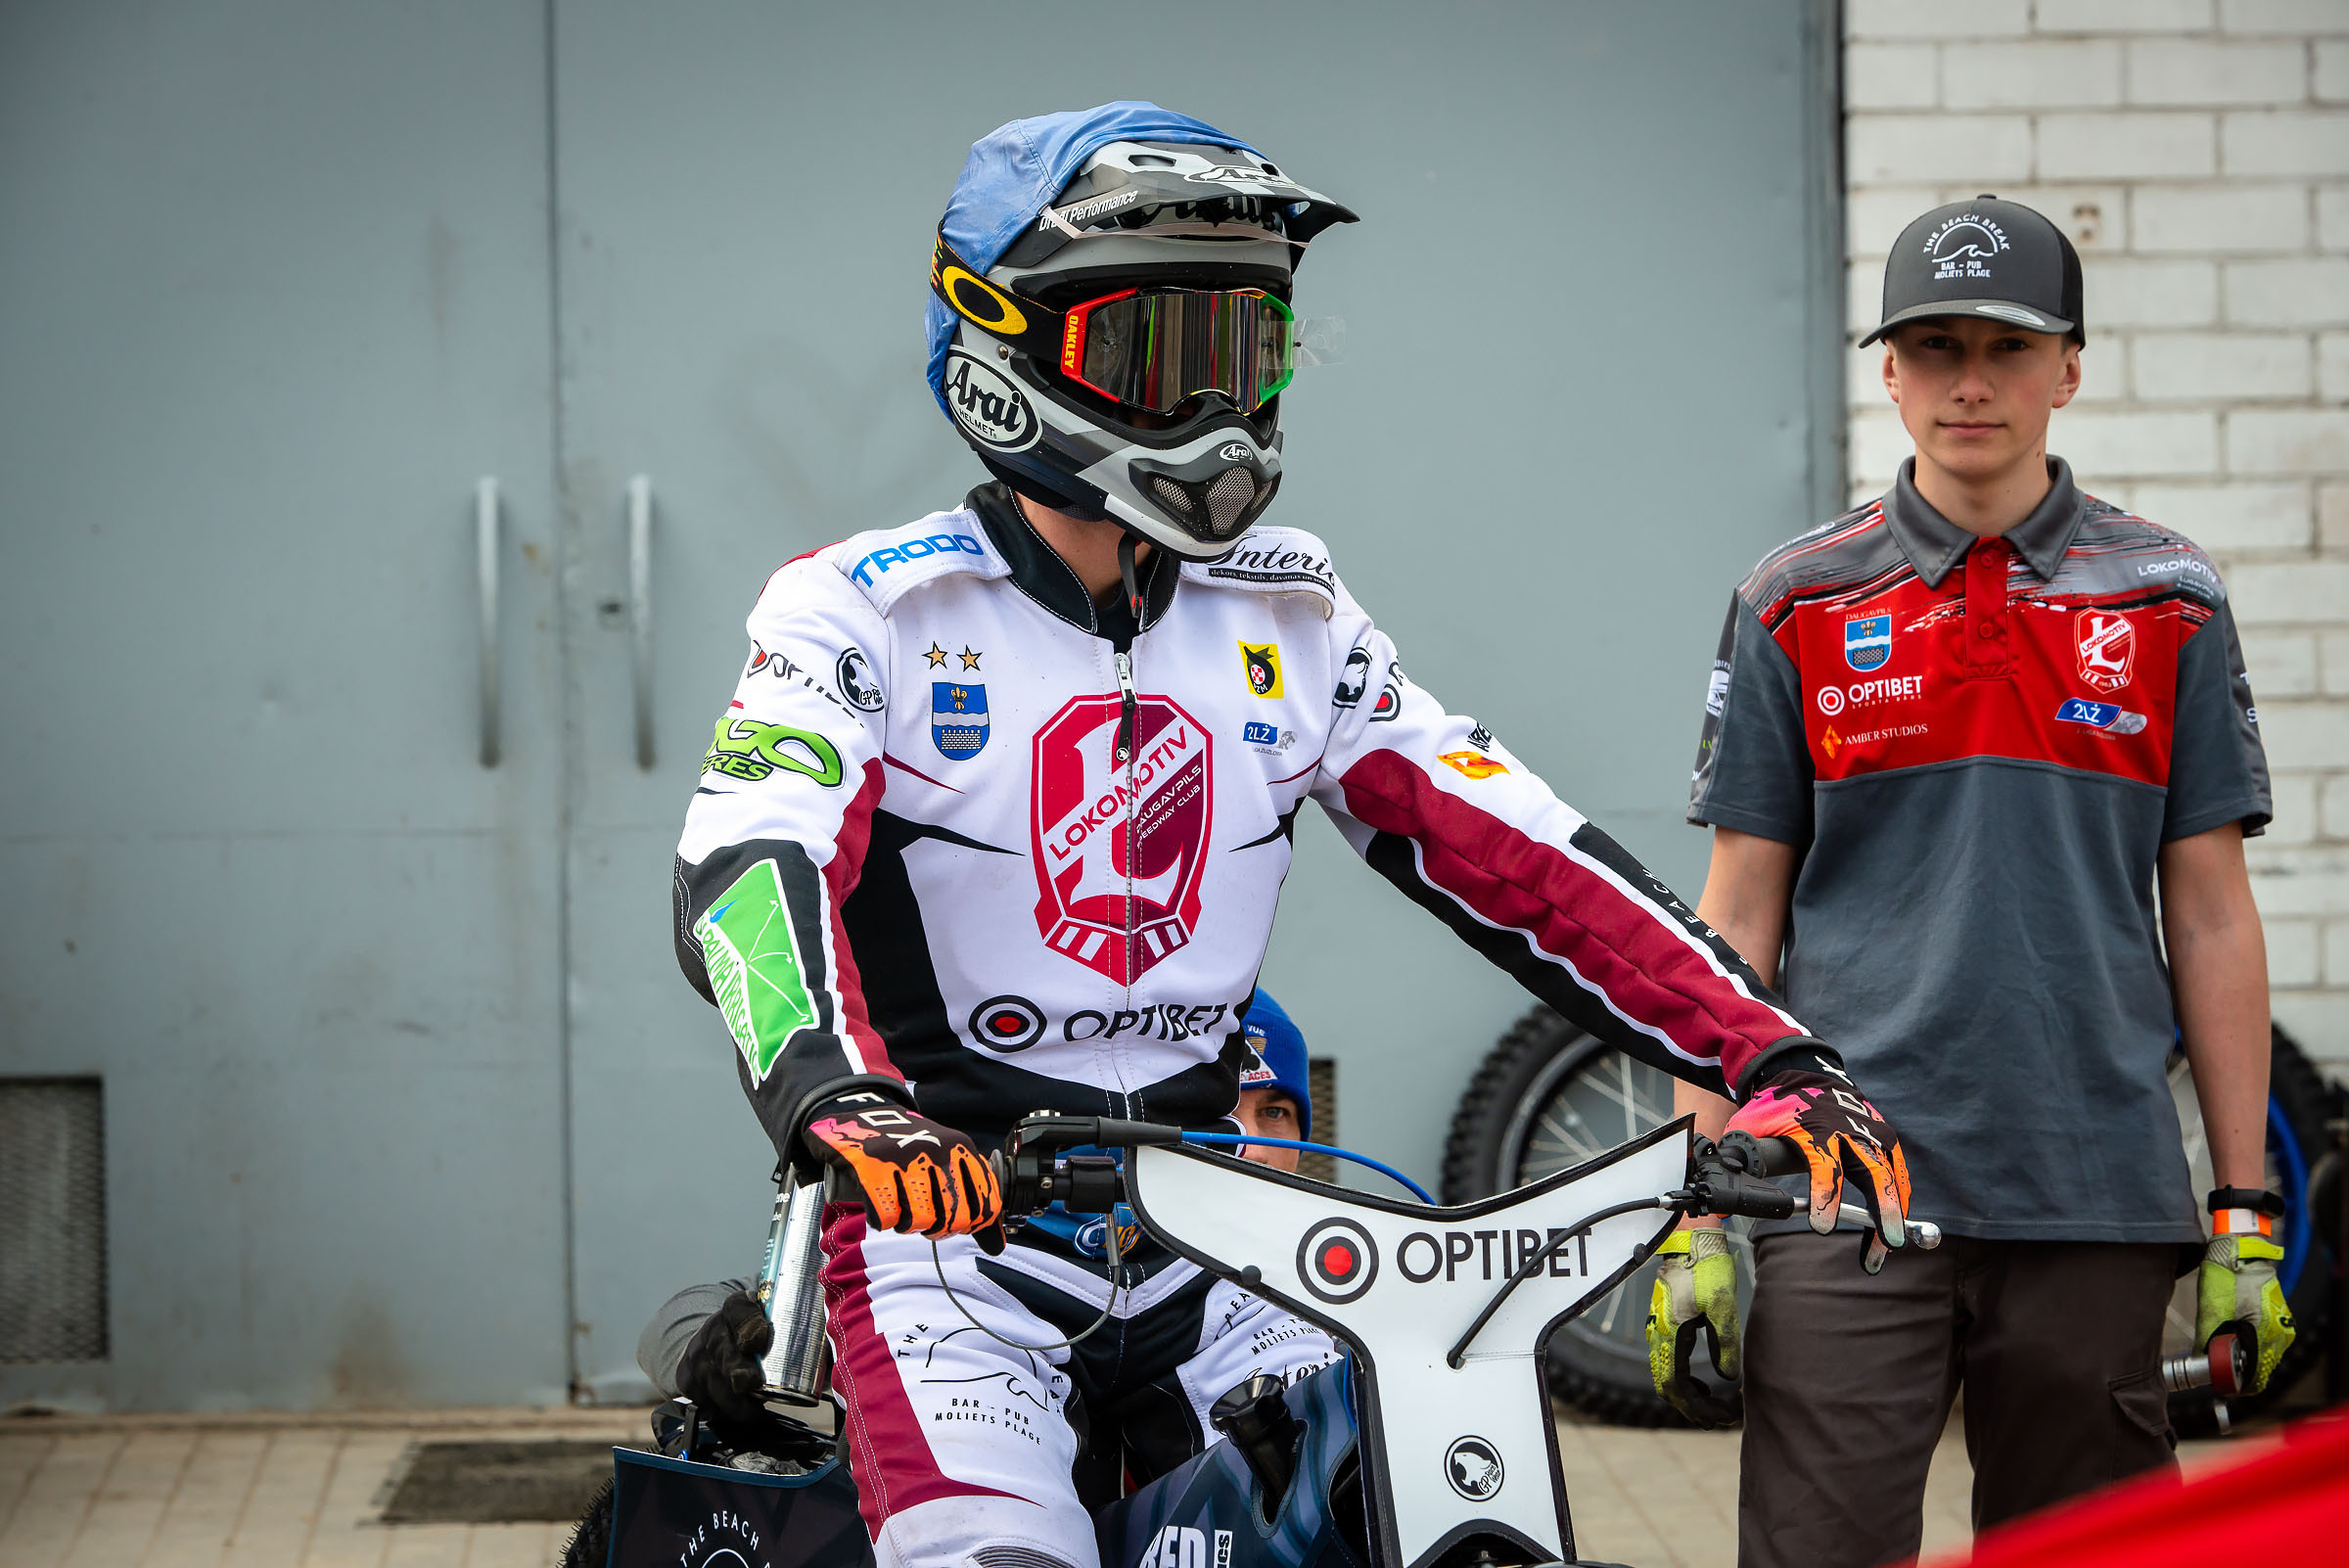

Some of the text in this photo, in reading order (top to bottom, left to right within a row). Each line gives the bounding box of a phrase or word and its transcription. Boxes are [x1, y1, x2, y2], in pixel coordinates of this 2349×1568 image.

[1069, 191, 1138, 223] Performance
[1923, 213, 2011, 254] THE BEACH BREAK
[1941, 261, 1956, 271] BAR
[1966, 260, 1982, 269] PUB
[1967, 268, 1991, 278] PLAGE
[1064, 314, 1080, 370] OAKLEY
[947, 360, 1022, 433] Arai
[958, 408, 994, 438] HELMET
[2137, 557, 2217, 584] LOKOMOTIV
[2081, 621, 2126, 653] LOKOMOTIV
[1848, 675, 1923, 703] OPTIBET
[1845, 723, 1928, 746] AMBER STUDIOS
[1048, 724, 1187, 861] LOKOMOTIV
[1176, 784, 1201, 807] CLUB
[1064, 1002, 1228, 1042] OPTIBET
[1815, 1055, 1882, 1149] FOX
[836, 1091, 942, 1149] FOX
[1396, 1226, 1592, 1284] OPTIBET
[898, 1323, 930, 1359] THE
[1251, 1329, 1297, 1356] MOLIETS
[951, 1398, 980, 1408] BAR
[1005, 1407, 1029, 1425] PUB
[935, 1411, 1041, 1446] MOLIETS PLAGE
[680, 1510, 760, 1568] THE BEACH
